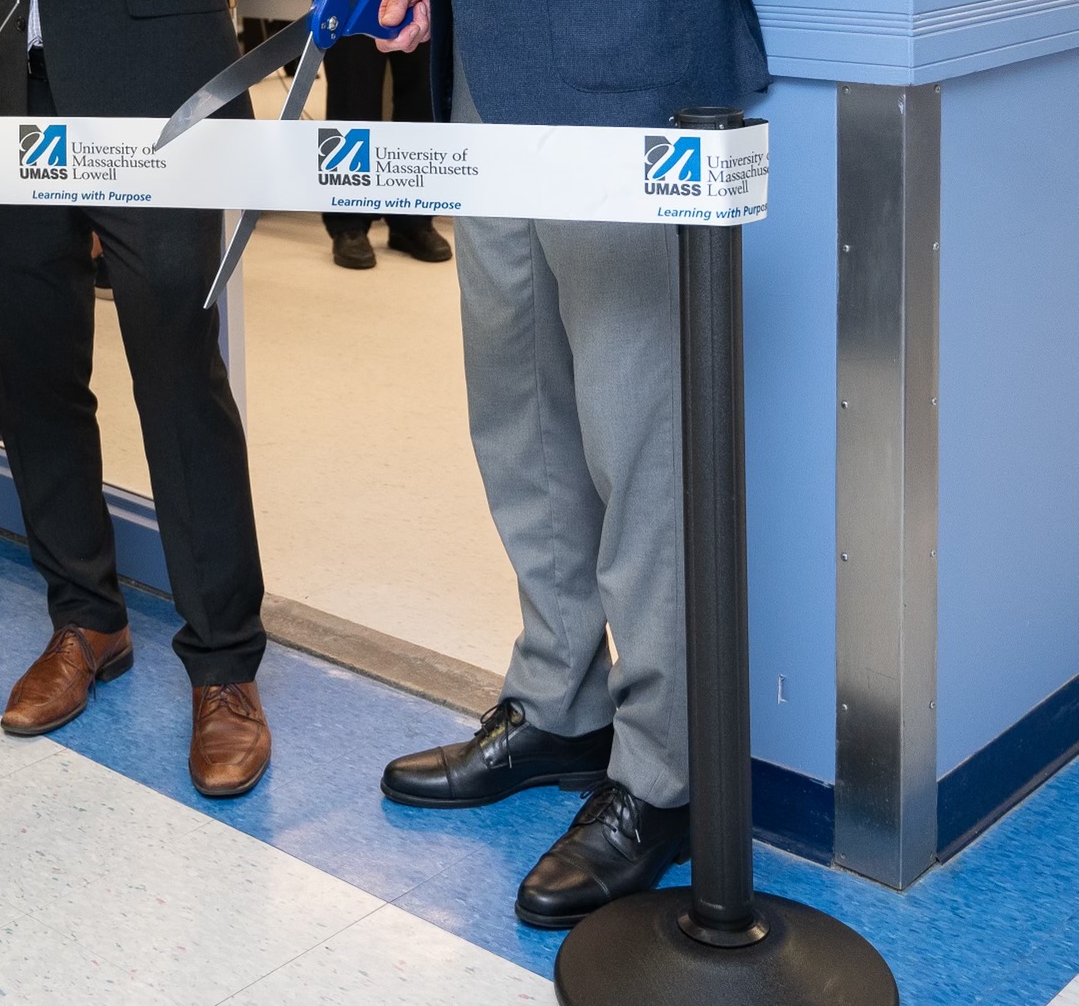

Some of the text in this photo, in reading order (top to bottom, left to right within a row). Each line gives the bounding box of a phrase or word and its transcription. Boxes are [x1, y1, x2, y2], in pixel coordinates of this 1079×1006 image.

[71, 142, 137, 158] University
[375, 147, 468, 164] University of
[72, 155, 167, 169] Massachusetts
[706, 151, 764, 169] University
[20, 168, 68, 180] UMASS
[72, 168, 118, 181] Lowell
[375, 161, 479, 176] Massachusetts
[318, 173, 371, 187] UMASS
[376, 174, 425, 188] Lowell
[644, 183, 701, 196] UMASS
[707, 180, 749, 197] Lowell
[32, 190, 152, 203] Learning with Purpose
[331, 197, 462, 212] Learning with Purpose
[657, 207, 712, 221] Learning
[716, 207, 741, 219] with
